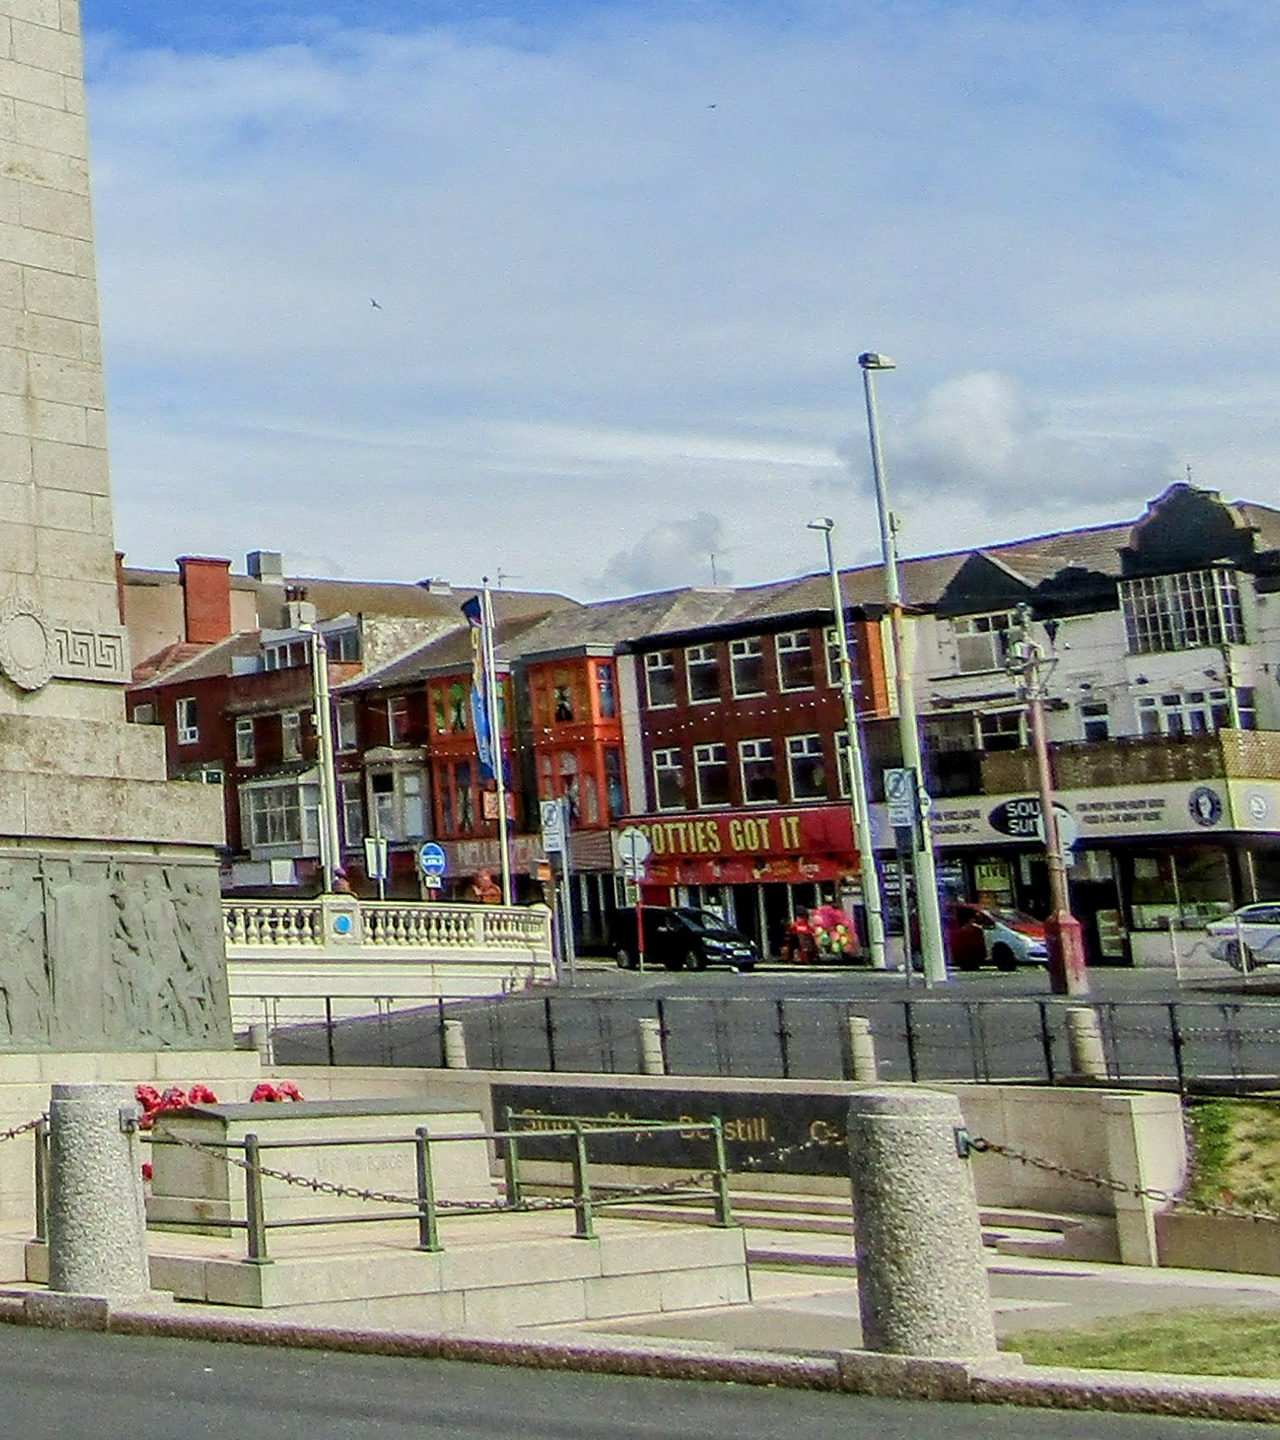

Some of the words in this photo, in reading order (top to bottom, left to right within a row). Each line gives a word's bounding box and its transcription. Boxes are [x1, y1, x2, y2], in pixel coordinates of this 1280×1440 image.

[638, 821, 721, 854] OTTIES
[729, 818, 770, 851] GOT
[780, 816, 801, 849] IT
